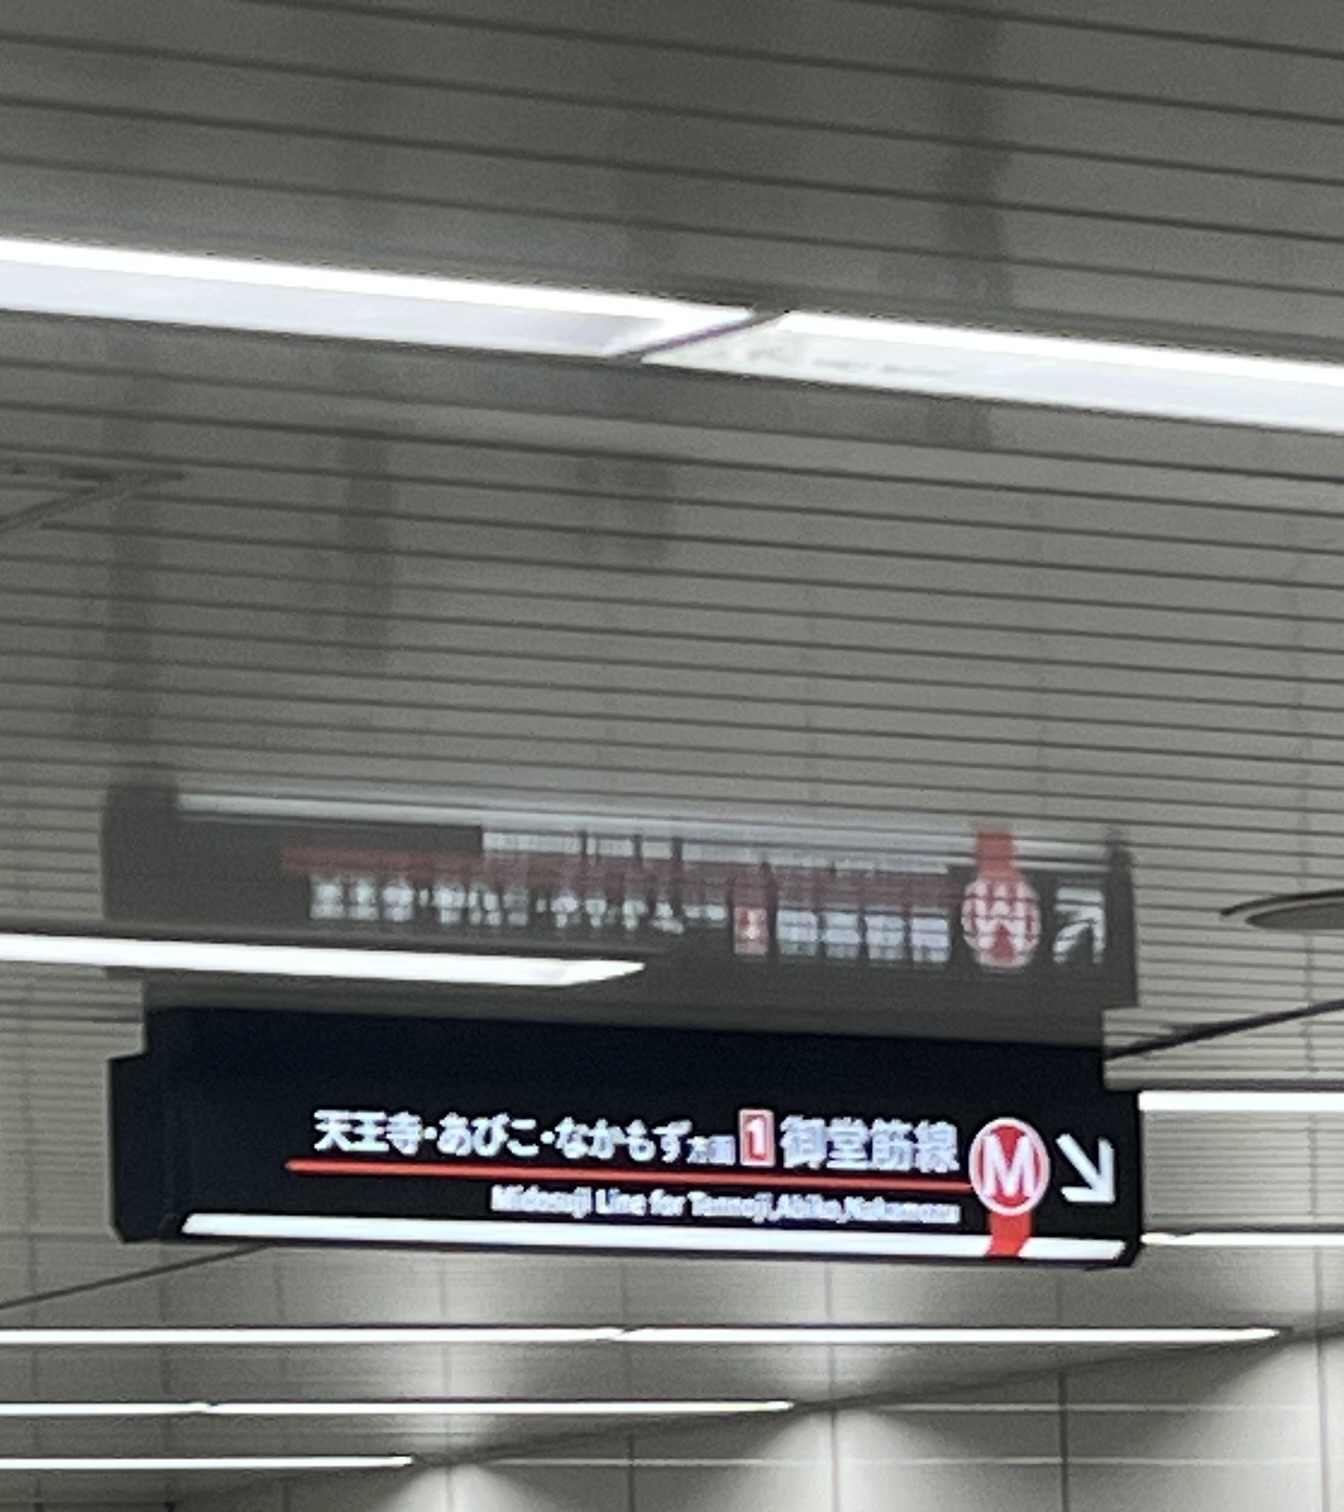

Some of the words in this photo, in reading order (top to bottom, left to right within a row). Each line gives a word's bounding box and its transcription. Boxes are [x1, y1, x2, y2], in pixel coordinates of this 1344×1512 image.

[779, 1114, 960, 1174] 御堂筋線
[981, 1133, 1034, 1198] M
